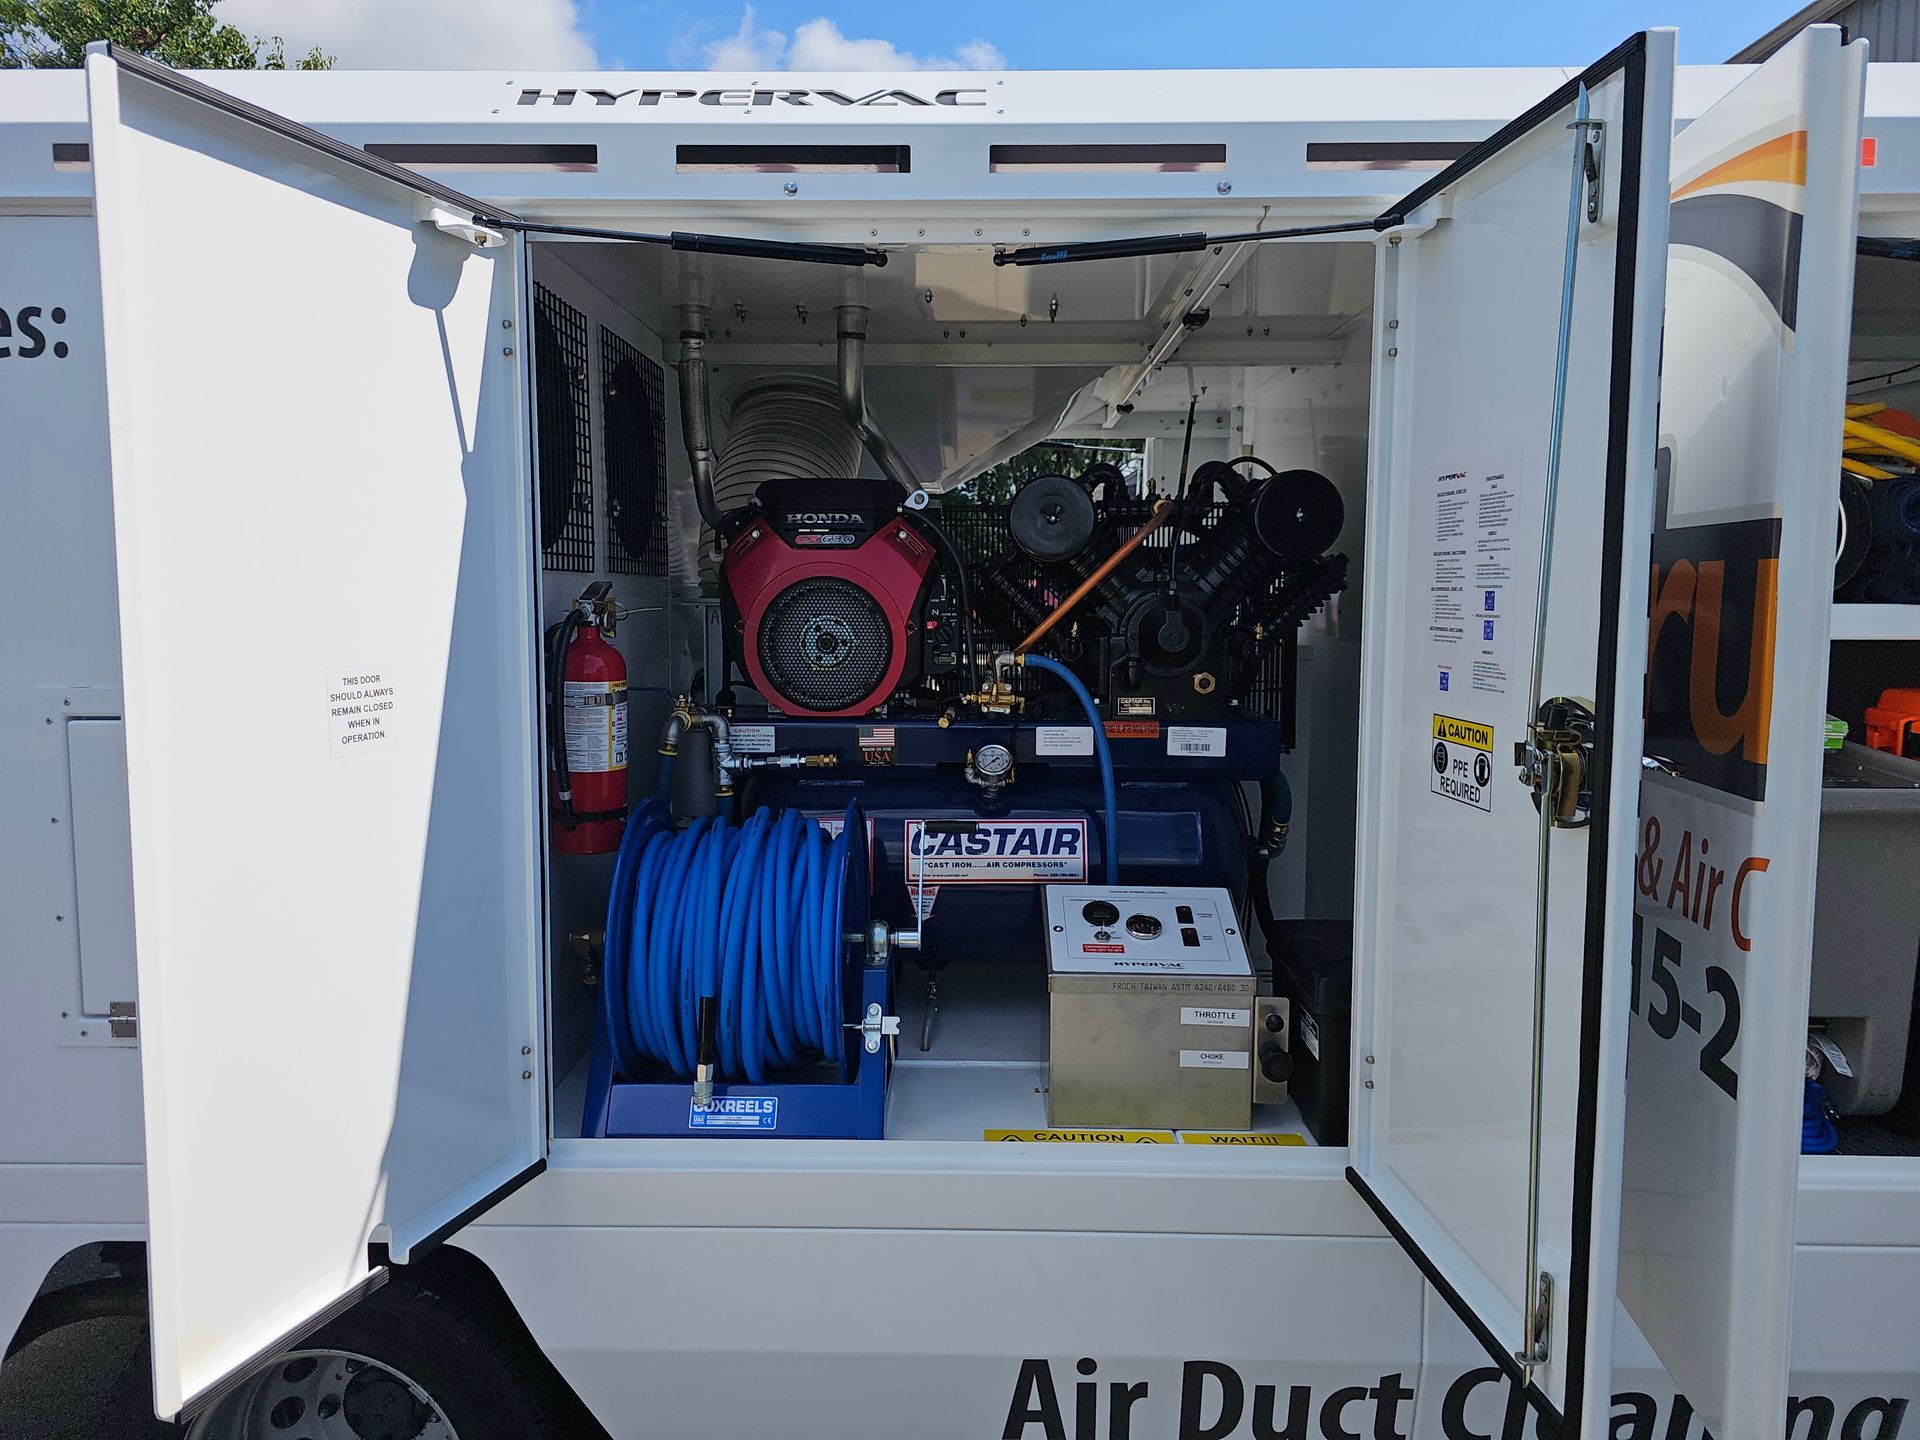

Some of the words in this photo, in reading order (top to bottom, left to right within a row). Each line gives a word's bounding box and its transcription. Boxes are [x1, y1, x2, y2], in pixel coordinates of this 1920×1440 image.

[515, 88, 987, 106] HYPERVAC
[785, 513, 866, 524] HONDA
[342, 676, 359, 686] THIS
[360, 674, 381, 685] DOOR
[330, 690, 363, 702] SHOULD
[363, 687, 394, 699] ALWAYS
[331, 705, 362, 718] REMAIN
[363, 701, 394, 713] CLOSED
[347, 718, 371, 729] WHEN
[372, 716, 381, 726] IN
[341, 730, 387, 745] OPERATION.
[1448, 722, 1489, 746] CAUTION
[863, 752, 890, 762] USA
[1452, 758, 1469, 779] PPE
[1440, 775, 1481, 804] REQUIRED
[911, 828, 1081, 856] CASTAIR
[1638, 816, 1663, 902] &
[1666, 830, 1725, 931] Air
[1140, 983, 1167, 991] TAIWAN
[1171, 983, 1190, 991] ASTM
[1194, 1010, 1237, 1020] THROTTLE
[1032, 1132, 1125, 1143] CAUTION
[1001, 1357, 1149, 1440] Air
[1179, 1360, 1415, 1440] Duct
